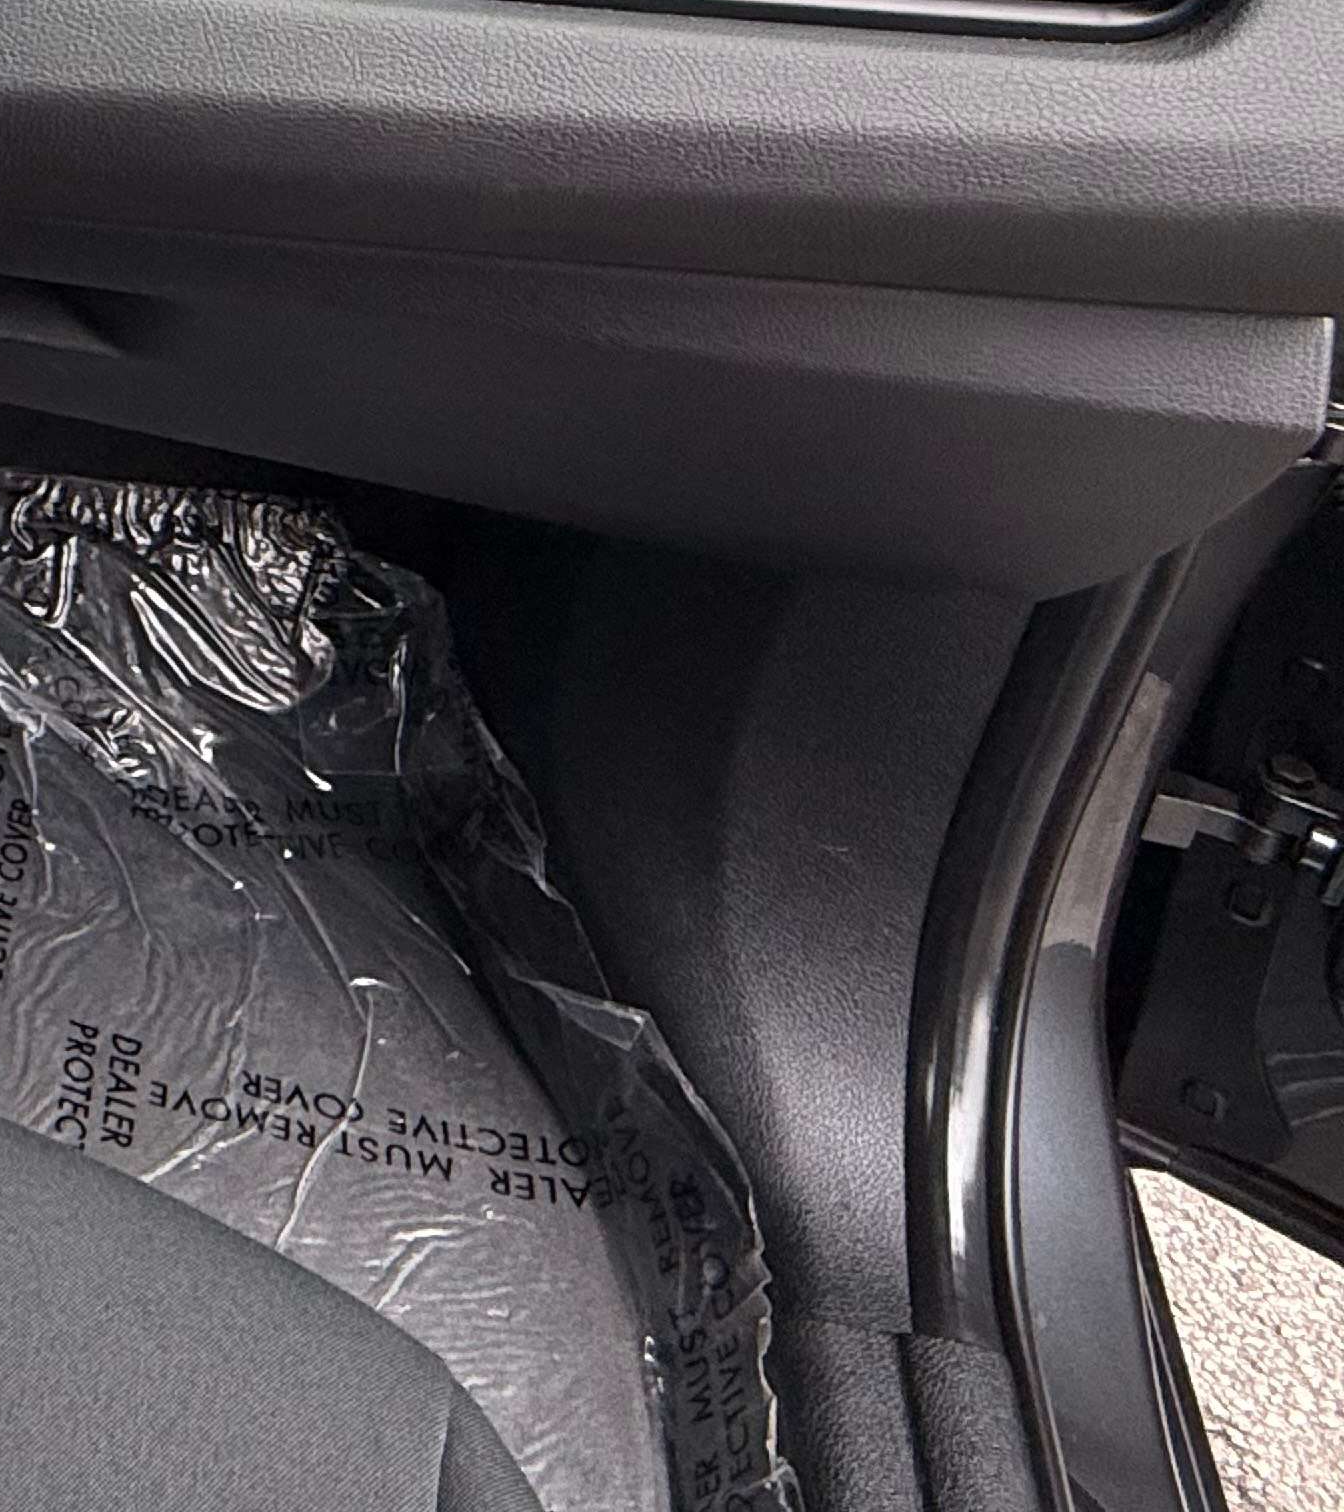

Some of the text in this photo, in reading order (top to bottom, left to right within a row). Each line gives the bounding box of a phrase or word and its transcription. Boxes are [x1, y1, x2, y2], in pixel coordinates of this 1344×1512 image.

[55, 1019, 100, 1152] PROTEC
[99, 1032, 143, 1149] DEALER
[149, 1080, 317, 1147] REMOVE
[241, 1069, 366, 1123] COVER
[337, 1130, 453, 1181] MUST
[666, 1307, 714, 1425] MUST
